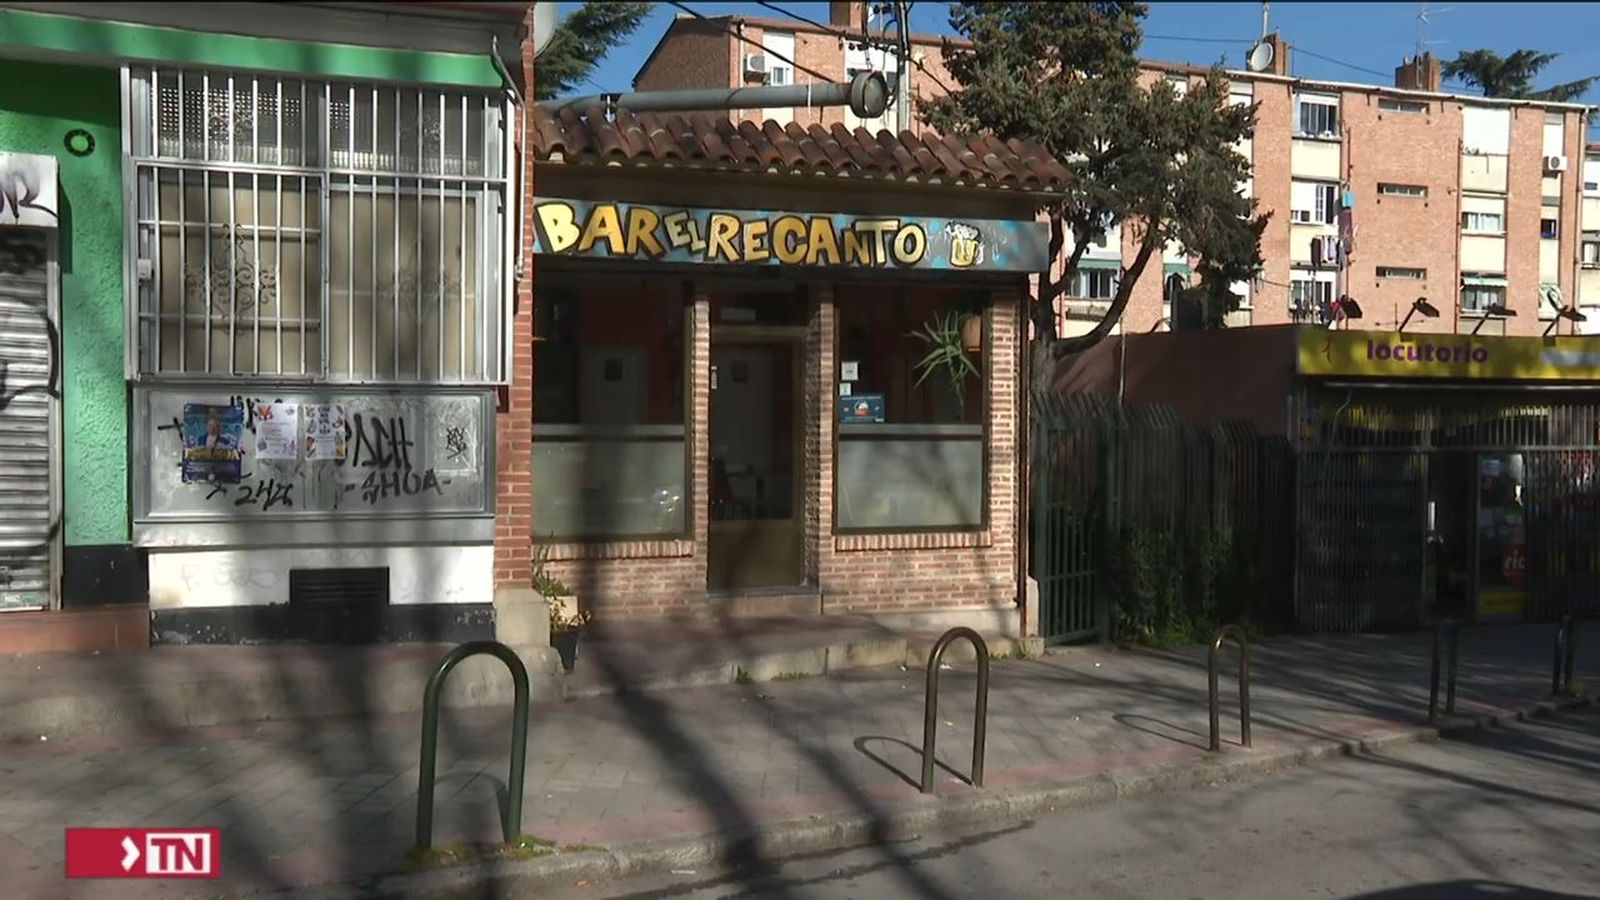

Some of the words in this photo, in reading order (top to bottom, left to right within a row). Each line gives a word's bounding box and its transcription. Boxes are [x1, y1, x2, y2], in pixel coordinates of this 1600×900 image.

[534, 202, 665, 257] BAR
[664, 210, 707, 253] EL
[706, 212, 927, 266] RECANTO
[1366, 339, 1489, 364] locutorio
